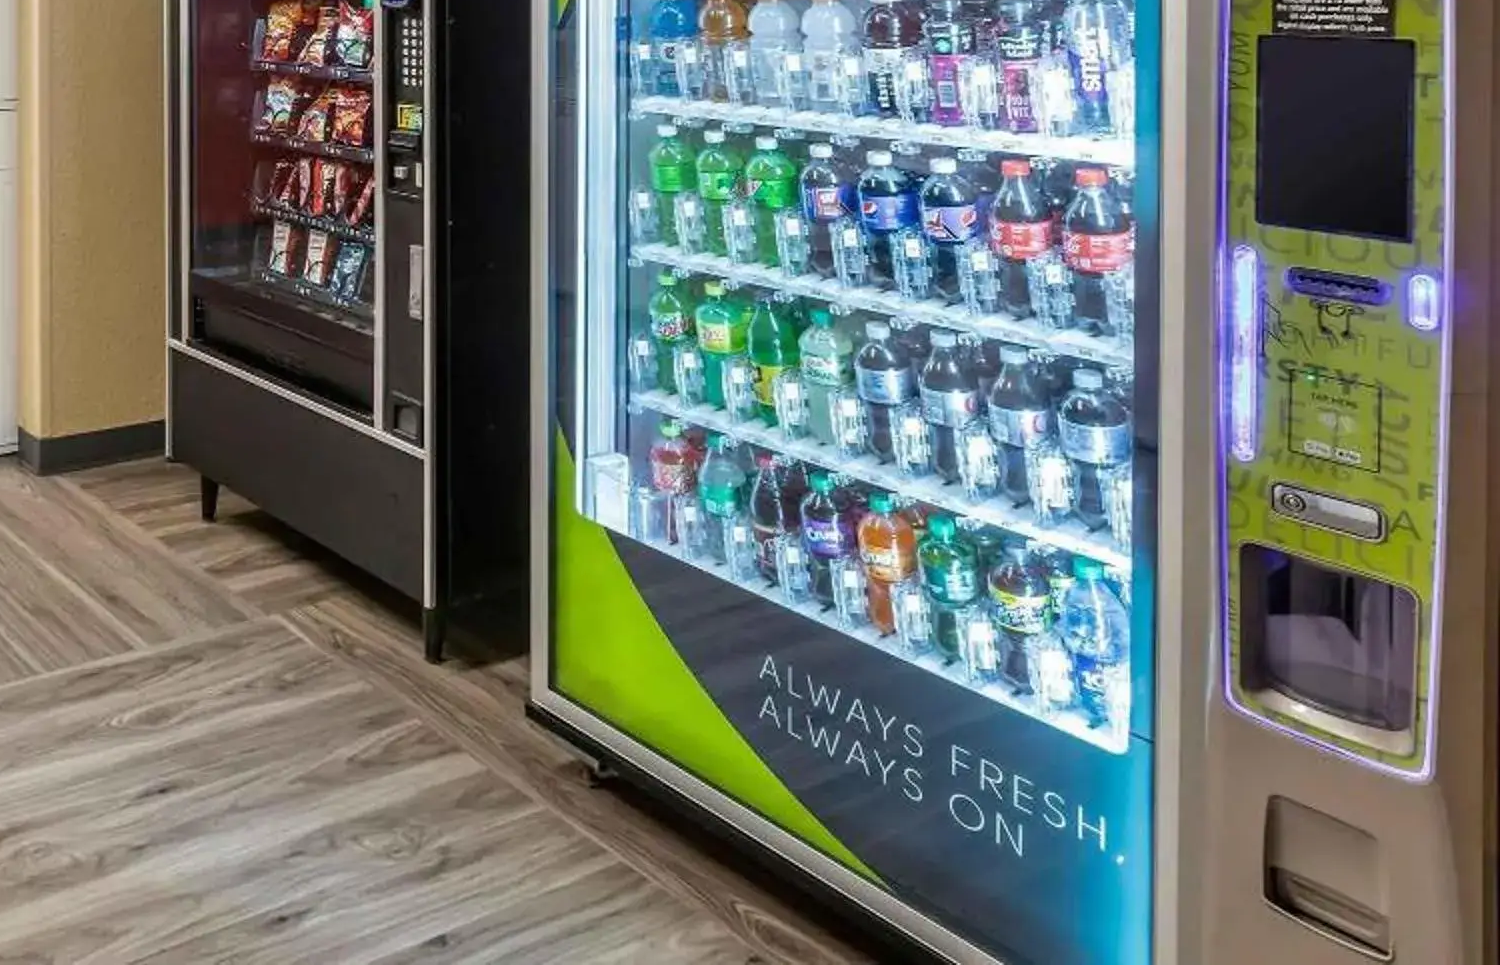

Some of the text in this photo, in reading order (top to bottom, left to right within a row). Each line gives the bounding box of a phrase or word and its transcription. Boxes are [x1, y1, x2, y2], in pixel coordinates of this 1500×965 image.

[758, 654, 925, 758] ALWAYS
[758, 695, 1025, 858] ALWAYS ON
